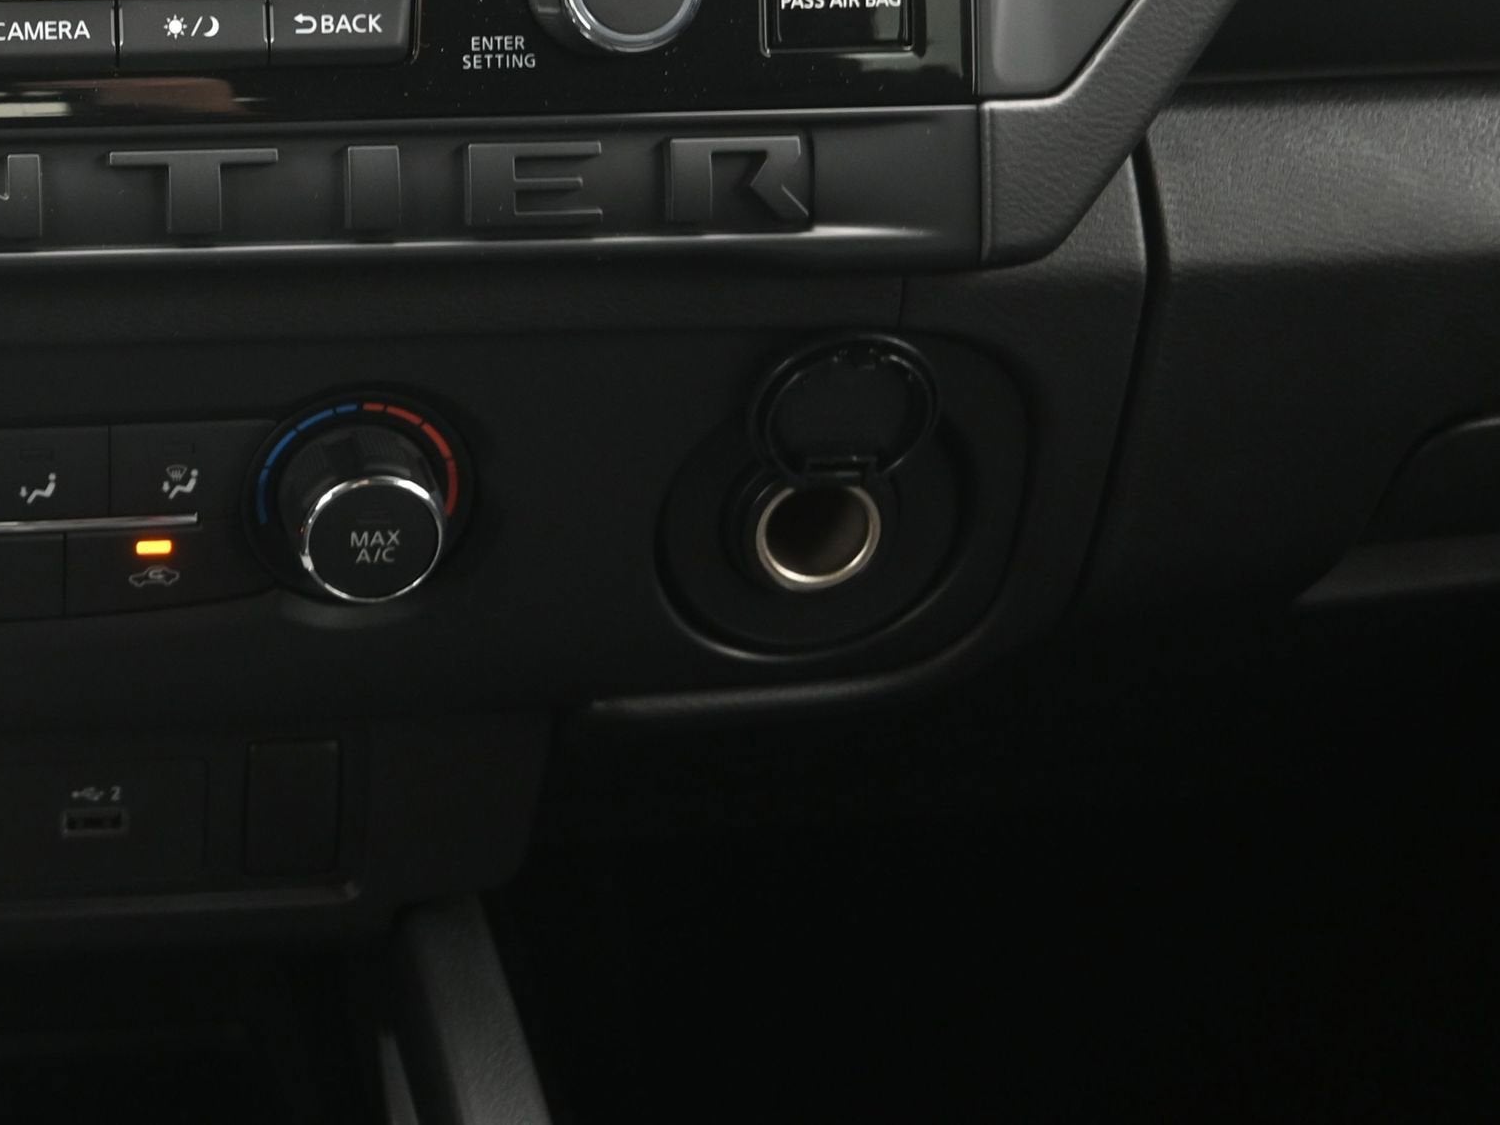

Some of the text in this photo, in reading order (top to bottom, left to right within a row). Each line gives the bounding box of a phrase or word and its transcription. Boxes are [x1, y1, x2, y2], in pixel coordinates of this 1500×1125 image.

[320, 13, 383, 35] BACK
[470, 35, 526, 52] ENTER
[461, 52, 537, 70] SETTING
[349, 528, 401, 548] MAX
[354, 546, 396, 564] A/C
[110, 785, 122, 802] 2
